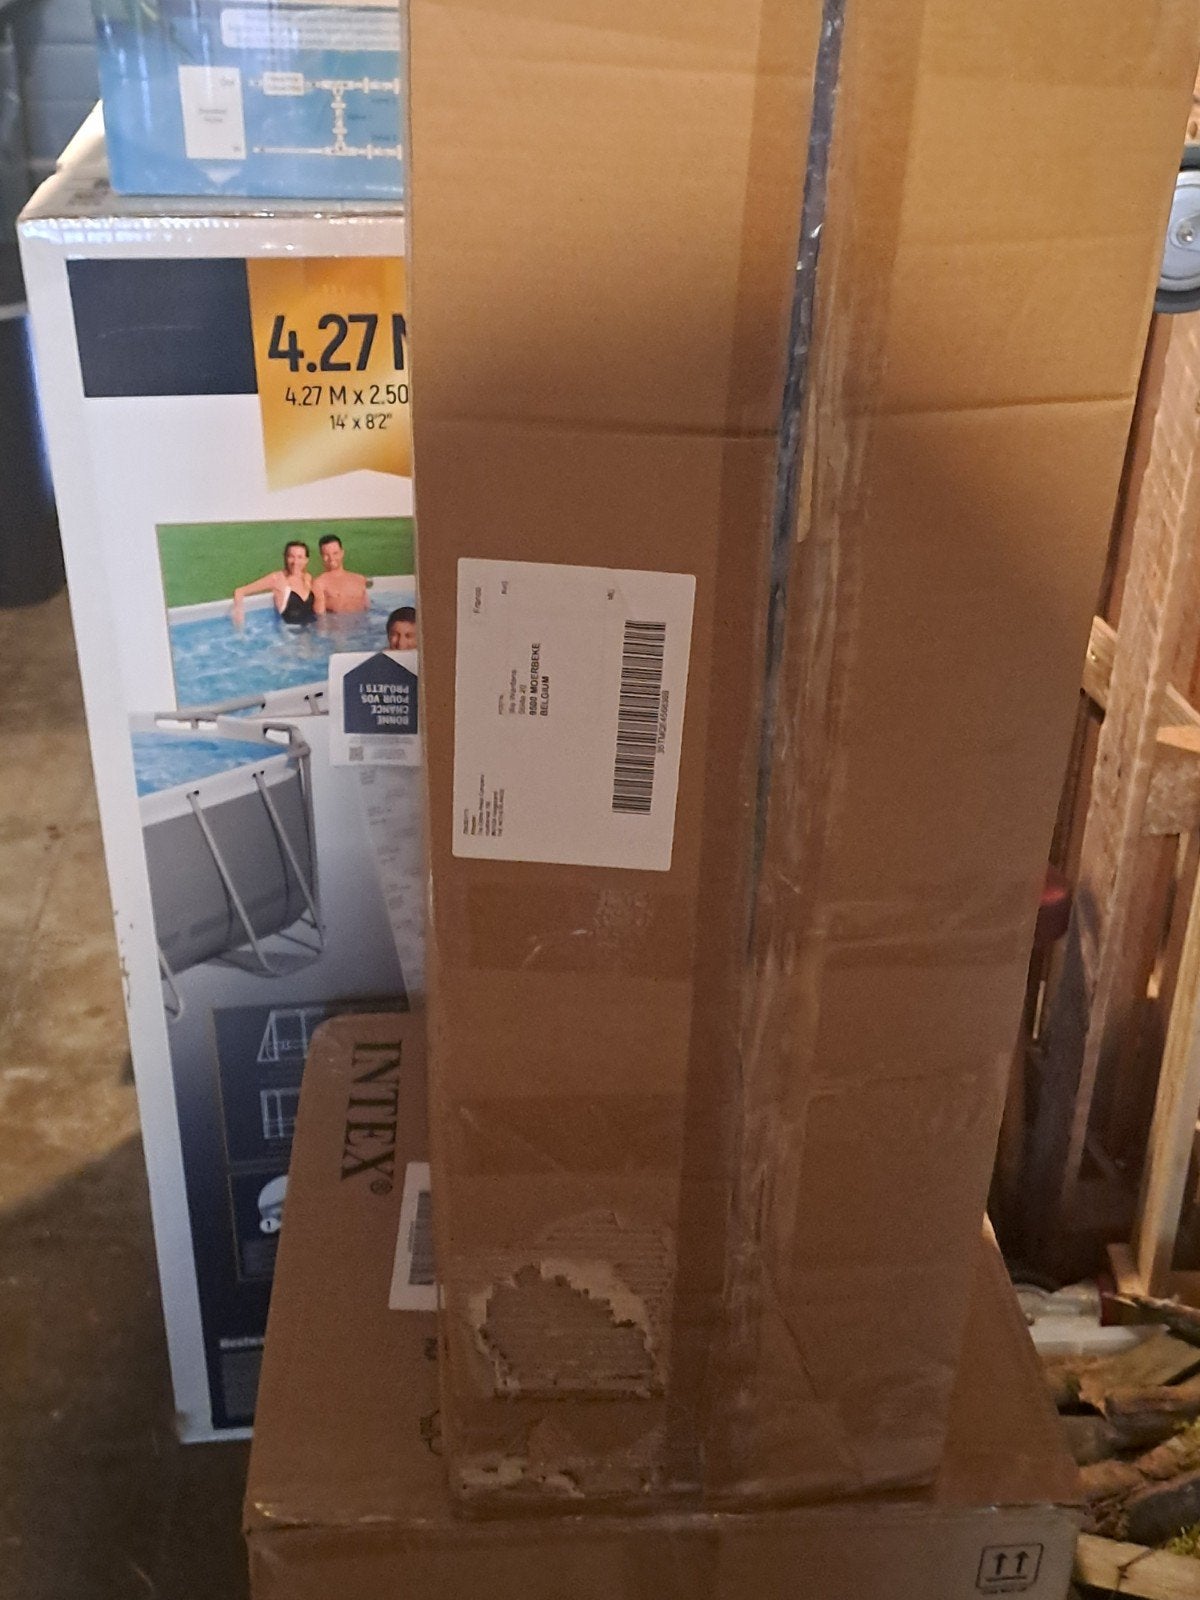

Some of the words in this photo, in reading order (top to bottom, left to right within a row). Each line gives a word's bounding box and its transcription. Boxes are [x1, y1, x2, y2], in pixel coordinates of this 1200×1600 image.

[268, 313, 378, 373] 4.27
[285, 385, 322, 407] 4.27
[330, 386, 347, 405] M
[353, 390, 364, 405] x
[370, 384, 408, 405] 2.50
[352, 417, 361, 430] x
[530, 643, 540, 694] MOERBEKE
[366, 684, 409, 693] PROJETS
[361, 694, 380, 704] VOS
[383, 694, 409, 704] POUR
[540, 675, 549, 716] BELGIUM
[370, 705, 409, 715] CHANCE
[377, 715, 409, 725] BONNE
